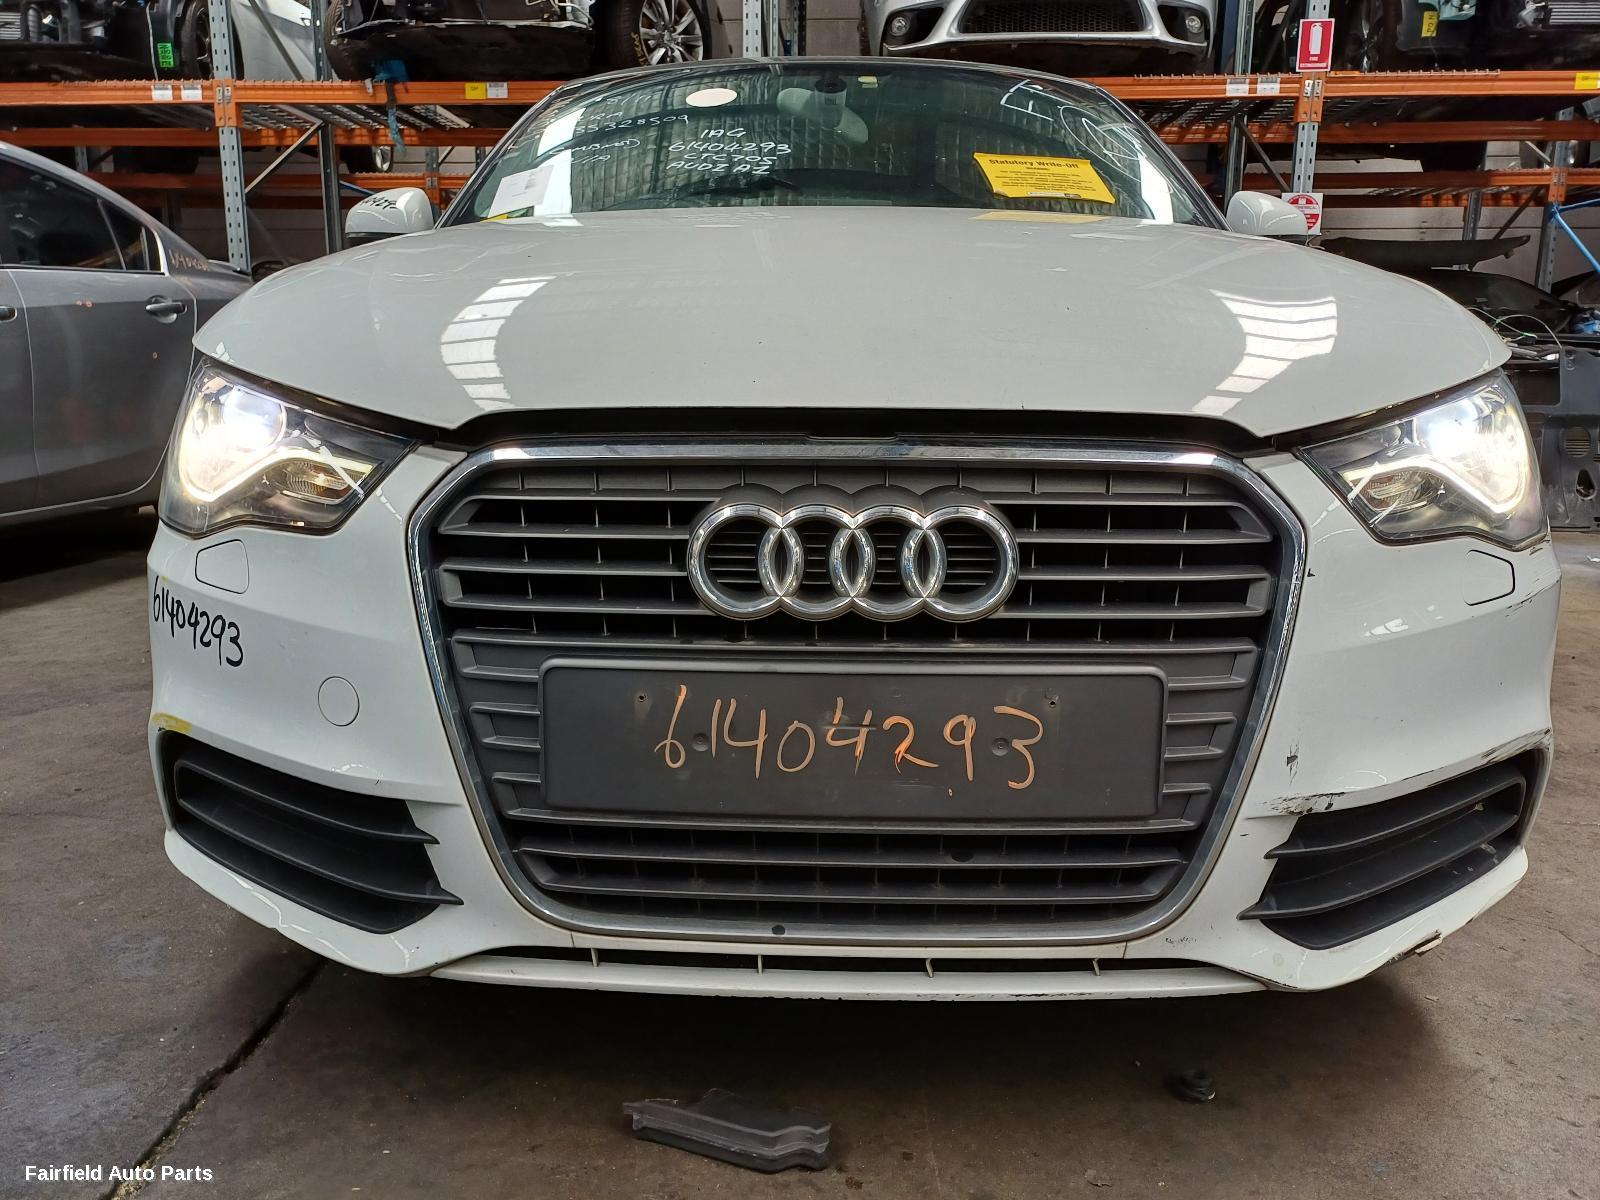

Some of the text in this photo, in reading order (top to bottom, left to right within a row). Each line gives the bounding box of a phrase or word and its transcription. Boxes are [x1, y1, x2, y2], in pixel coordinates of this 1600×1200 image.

[668, 141, 792, 155] 61404293
[989, 159, 1034, 167] Statutory
[1036, 161, 1080, 169] Write-Off
[153, 575, 244, 668] 61404293
[654, 684, 1043, 790] 61404293
